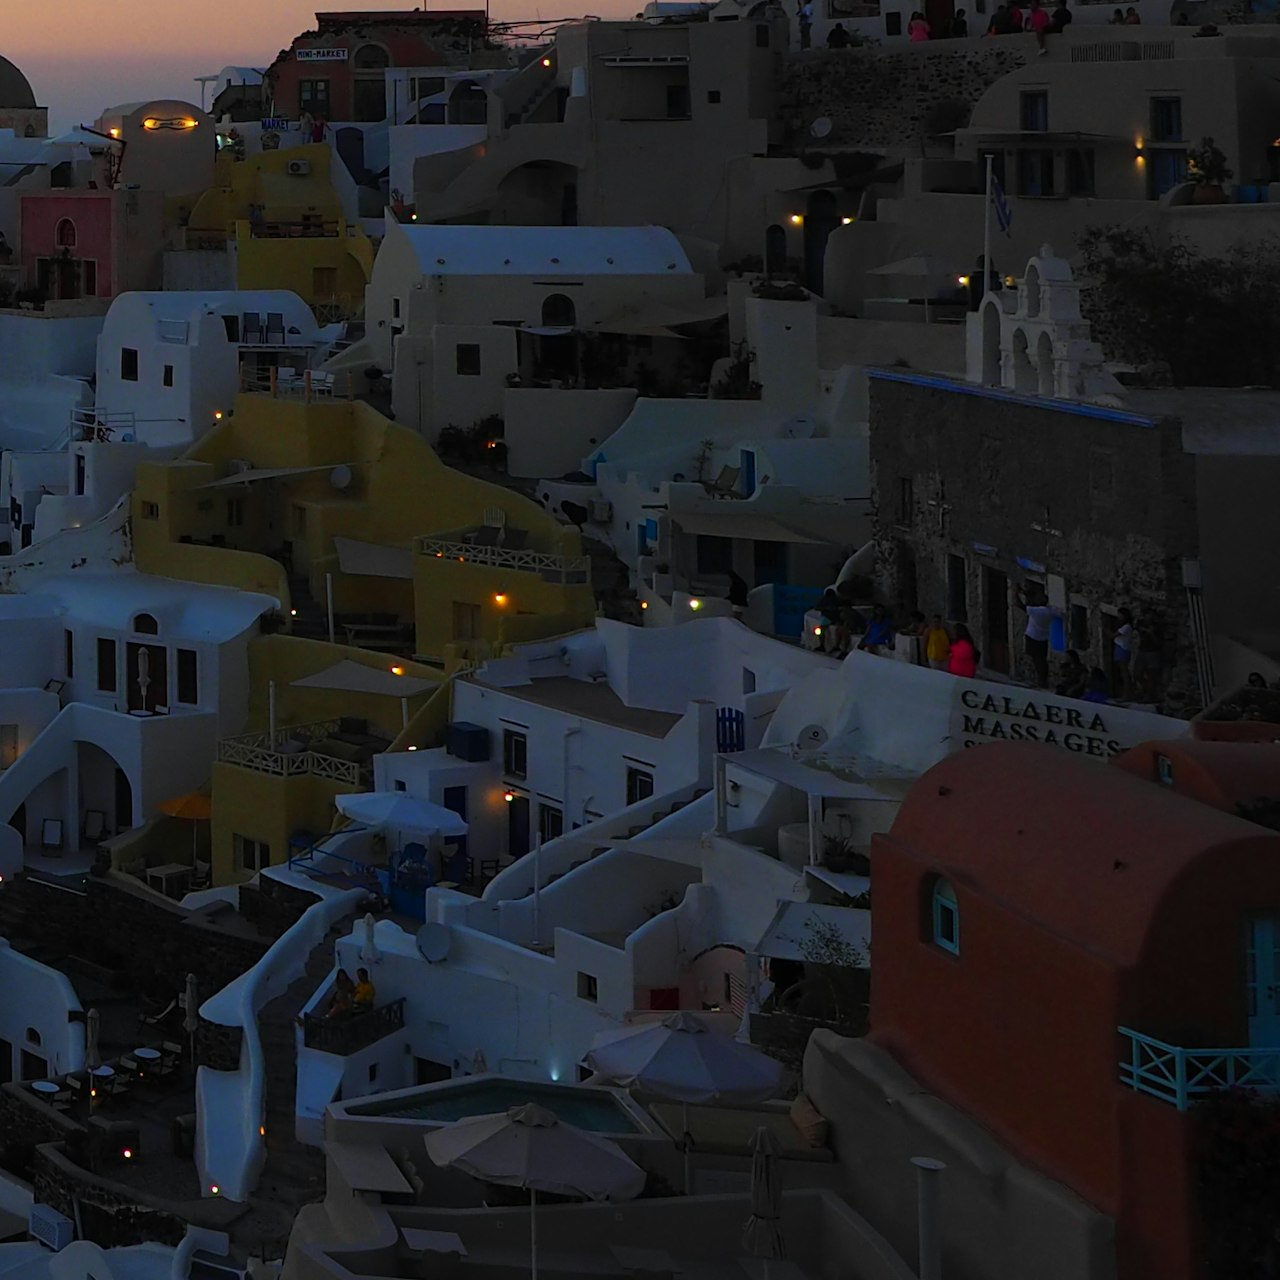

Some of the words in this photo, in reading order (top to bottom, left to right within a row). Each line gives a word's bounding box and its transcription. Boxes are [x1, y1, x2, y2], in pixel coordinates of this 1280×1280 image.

[297, 50, 346, 58] MINI-MARKET
[261, 119, 289, 130] MARKET
[962, 715, 1122, 757] MASSAGES
